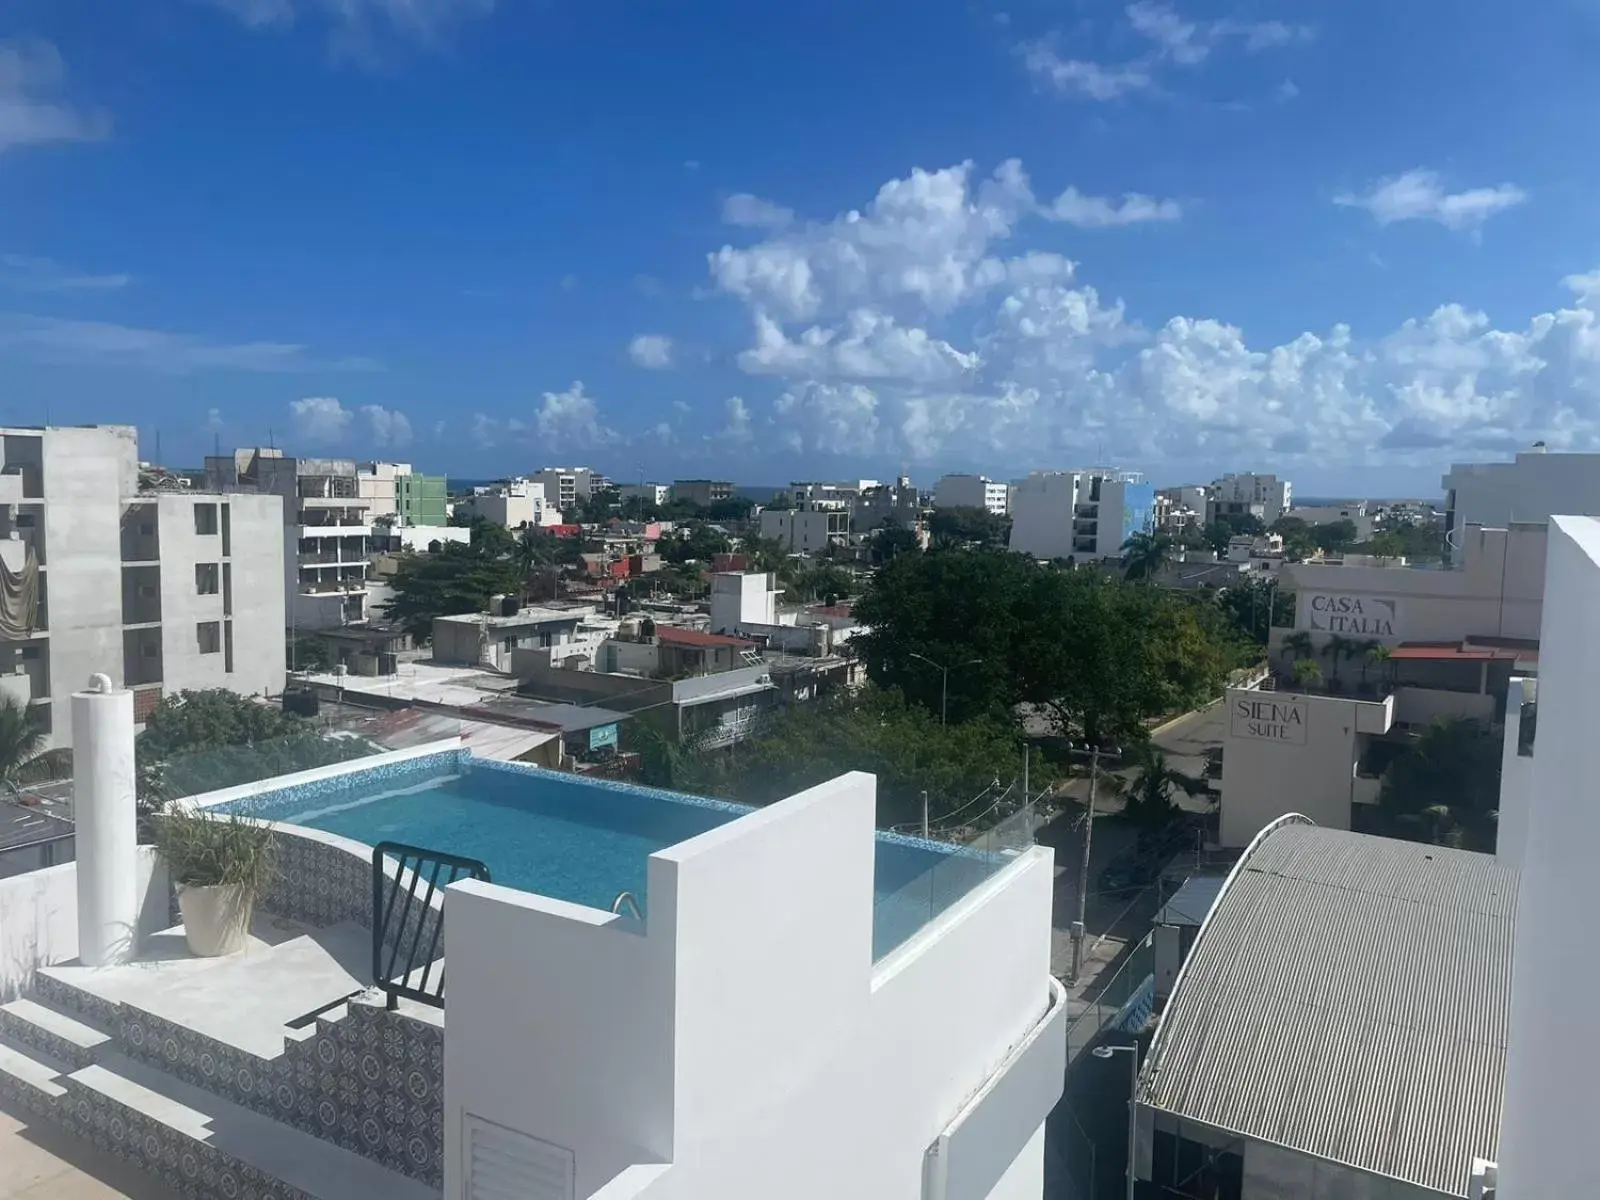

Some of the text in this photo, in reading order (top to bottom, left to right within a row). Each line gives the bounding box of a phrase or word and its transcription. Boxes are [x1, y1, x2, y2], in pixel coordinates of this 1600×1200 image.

[1311, 595, 1364, 614] CASA
[1329, 616, 1394, 636] ITALIA
[1237, 700, 1301, 725] SIENA
[1248, 721, 1290, 740] SUITE
